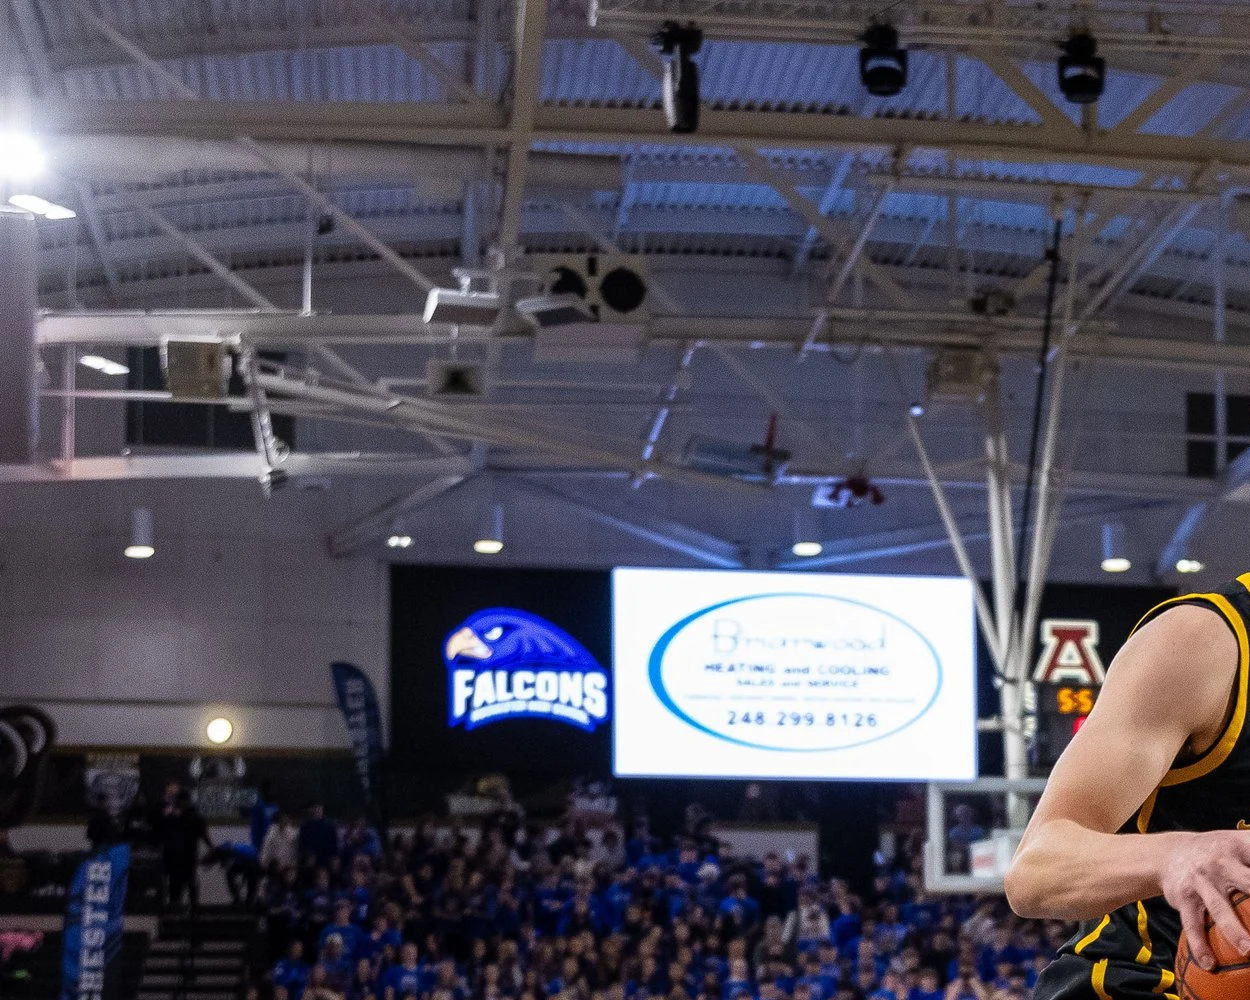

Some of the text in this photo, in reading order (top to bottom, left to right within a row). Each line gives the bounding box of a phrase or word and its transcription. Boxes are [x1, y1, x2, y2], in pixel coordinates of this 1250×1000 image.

[704, 663, 890, 676] HEATING and COOLING
[452, 668, 607, 719] FALCONS
[727, 711, 878, 727] 248 299 8126
